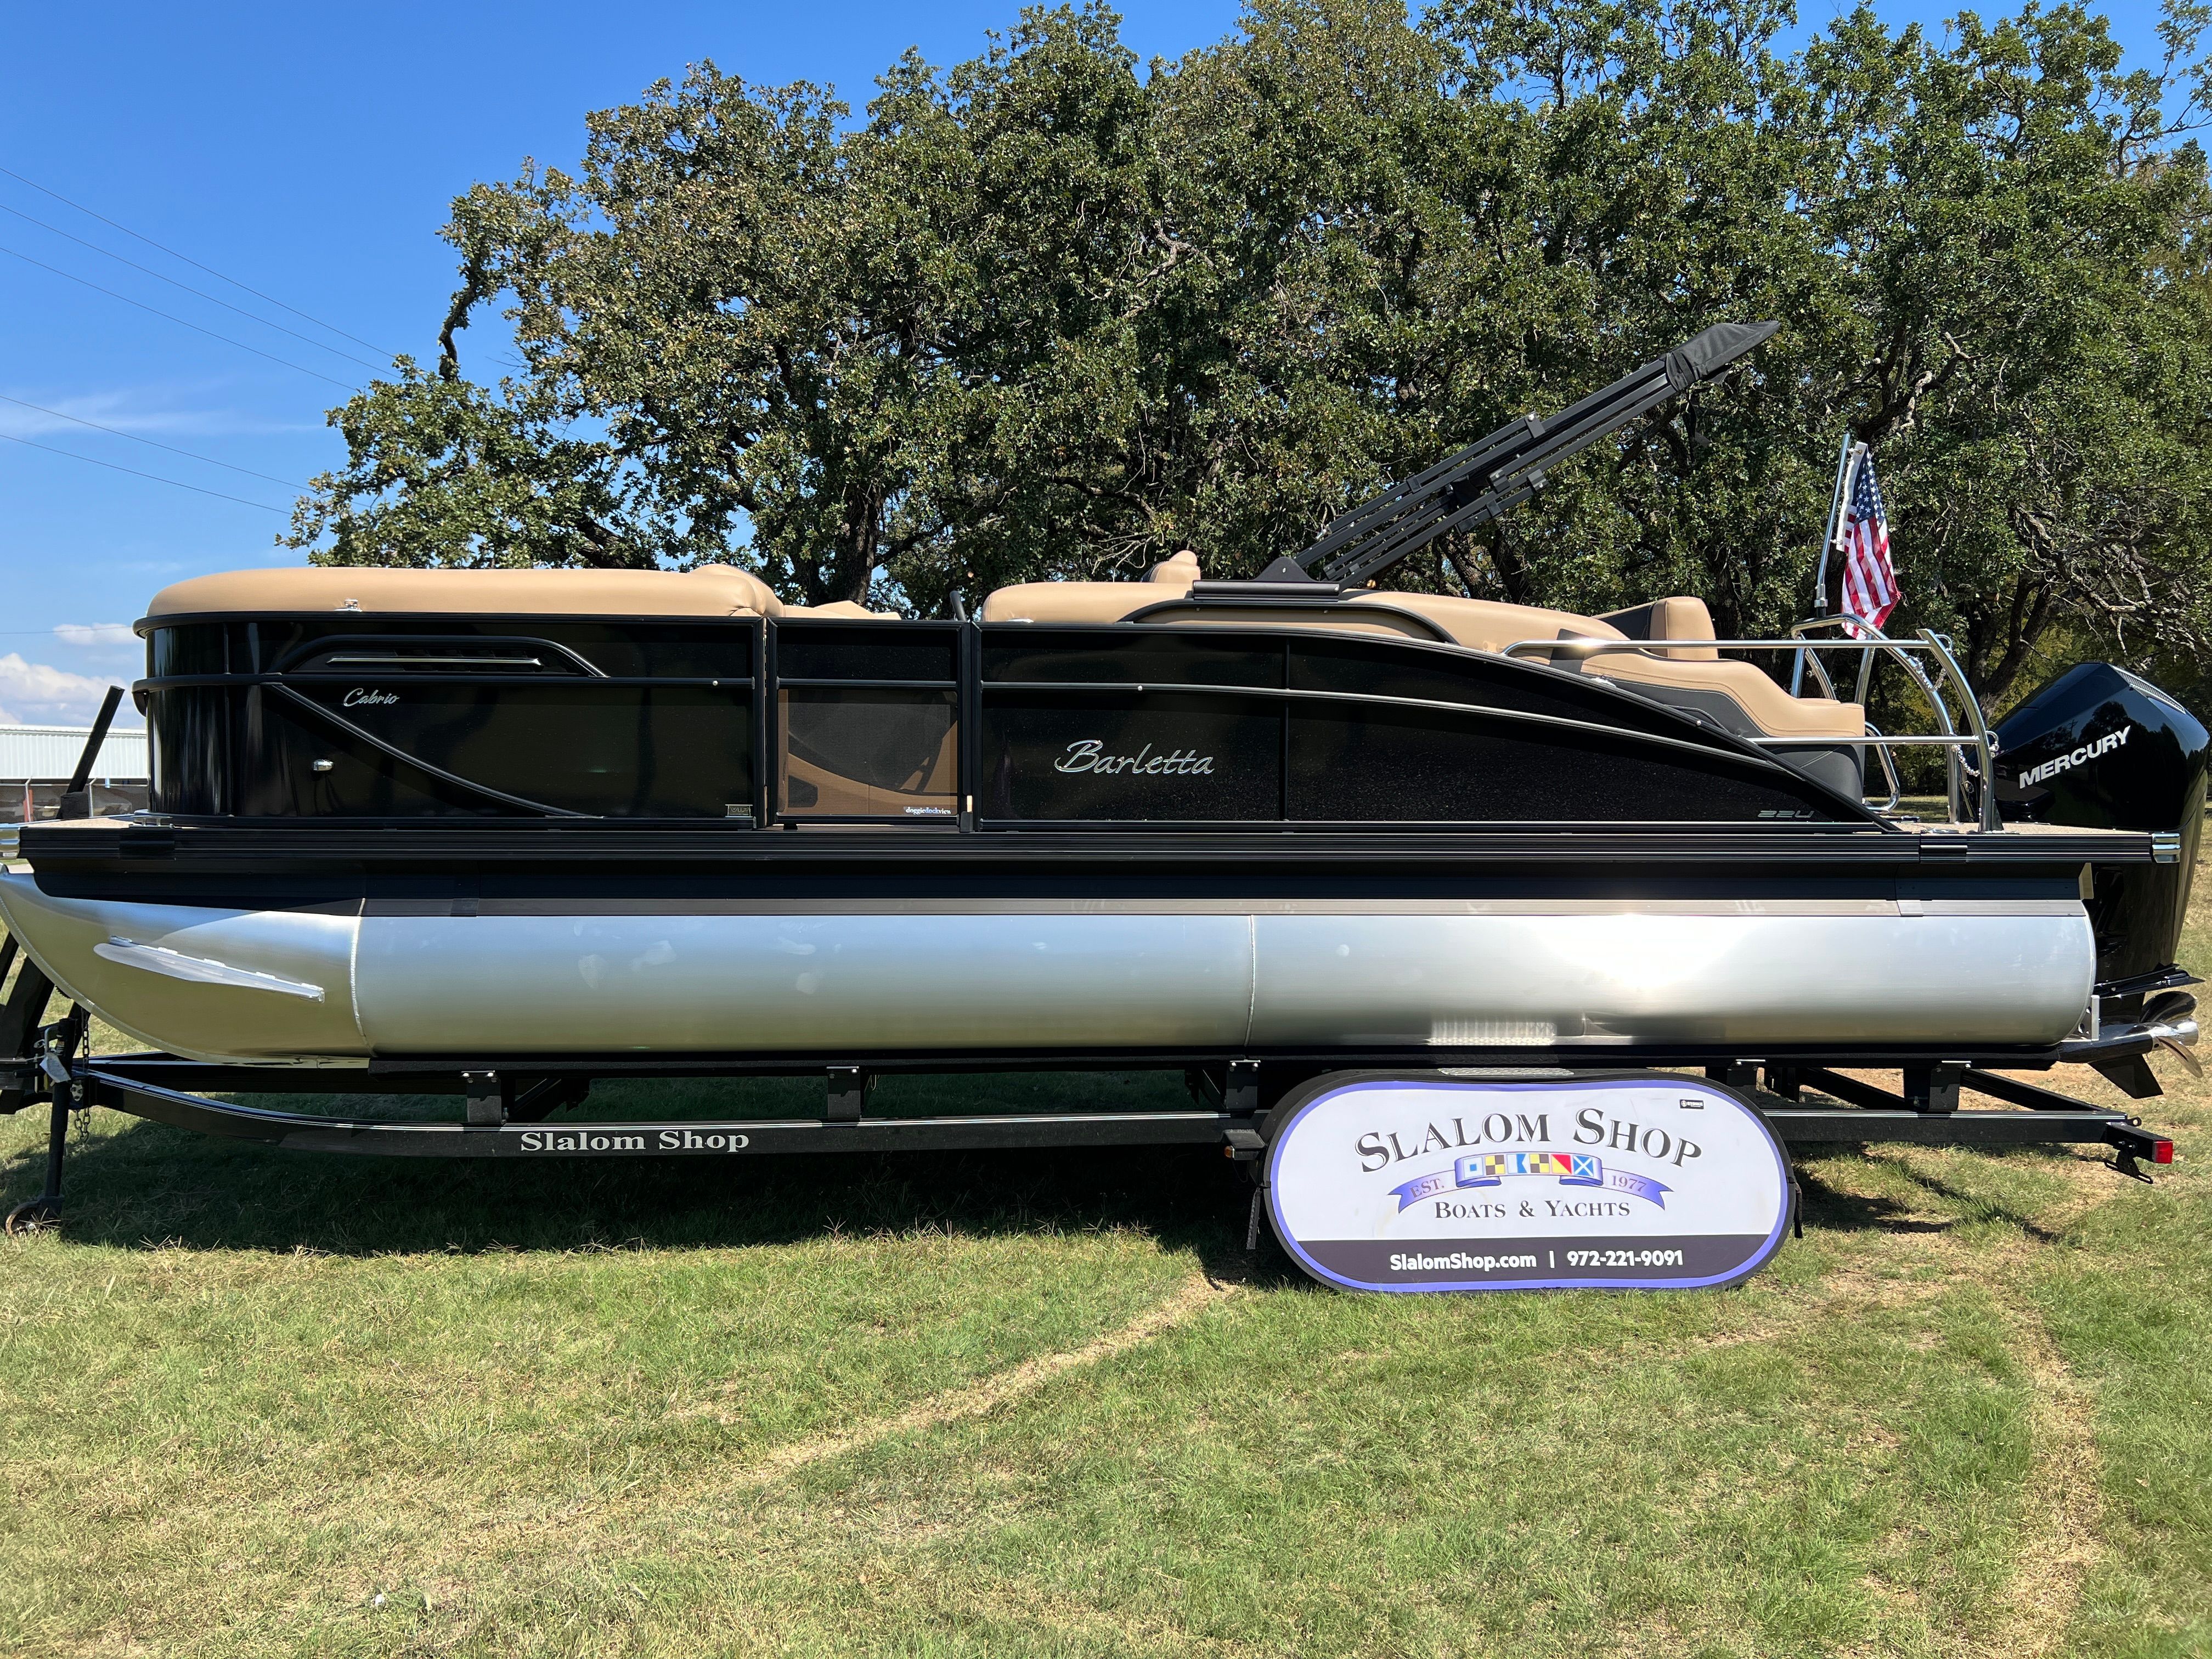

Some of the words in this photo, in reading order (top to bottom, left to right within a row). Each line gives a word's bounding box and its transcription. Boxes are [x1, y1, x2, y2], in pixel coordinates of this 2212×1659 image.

[343, 688, 400, 707] Cabrio
[1054, 740, 1215, 774] Barletta
[2019, 725, 2130, 789] MERCURY
[521, 1132, 646, 1151] Slalom
[659, 1131, 749, 1153] Shop
[1355, 1113, 1552, 1172] SLALOM
[1573, 1108, 1702, 1168] SHOP
[1409, 1178, 1445, 1198] EST.
[1611, 1175, 1647, 1192] 1977
[1435, 1201, 1506, 1218] BOATS
[1519, 1200, 1536, 1217] &
[1545, 1200, 1630, 1217] YACHTS
[1390, 1252, 1537, 1271] SlalomShop.com
[1567, 1250, 1683, 1266] 972-221-9091
